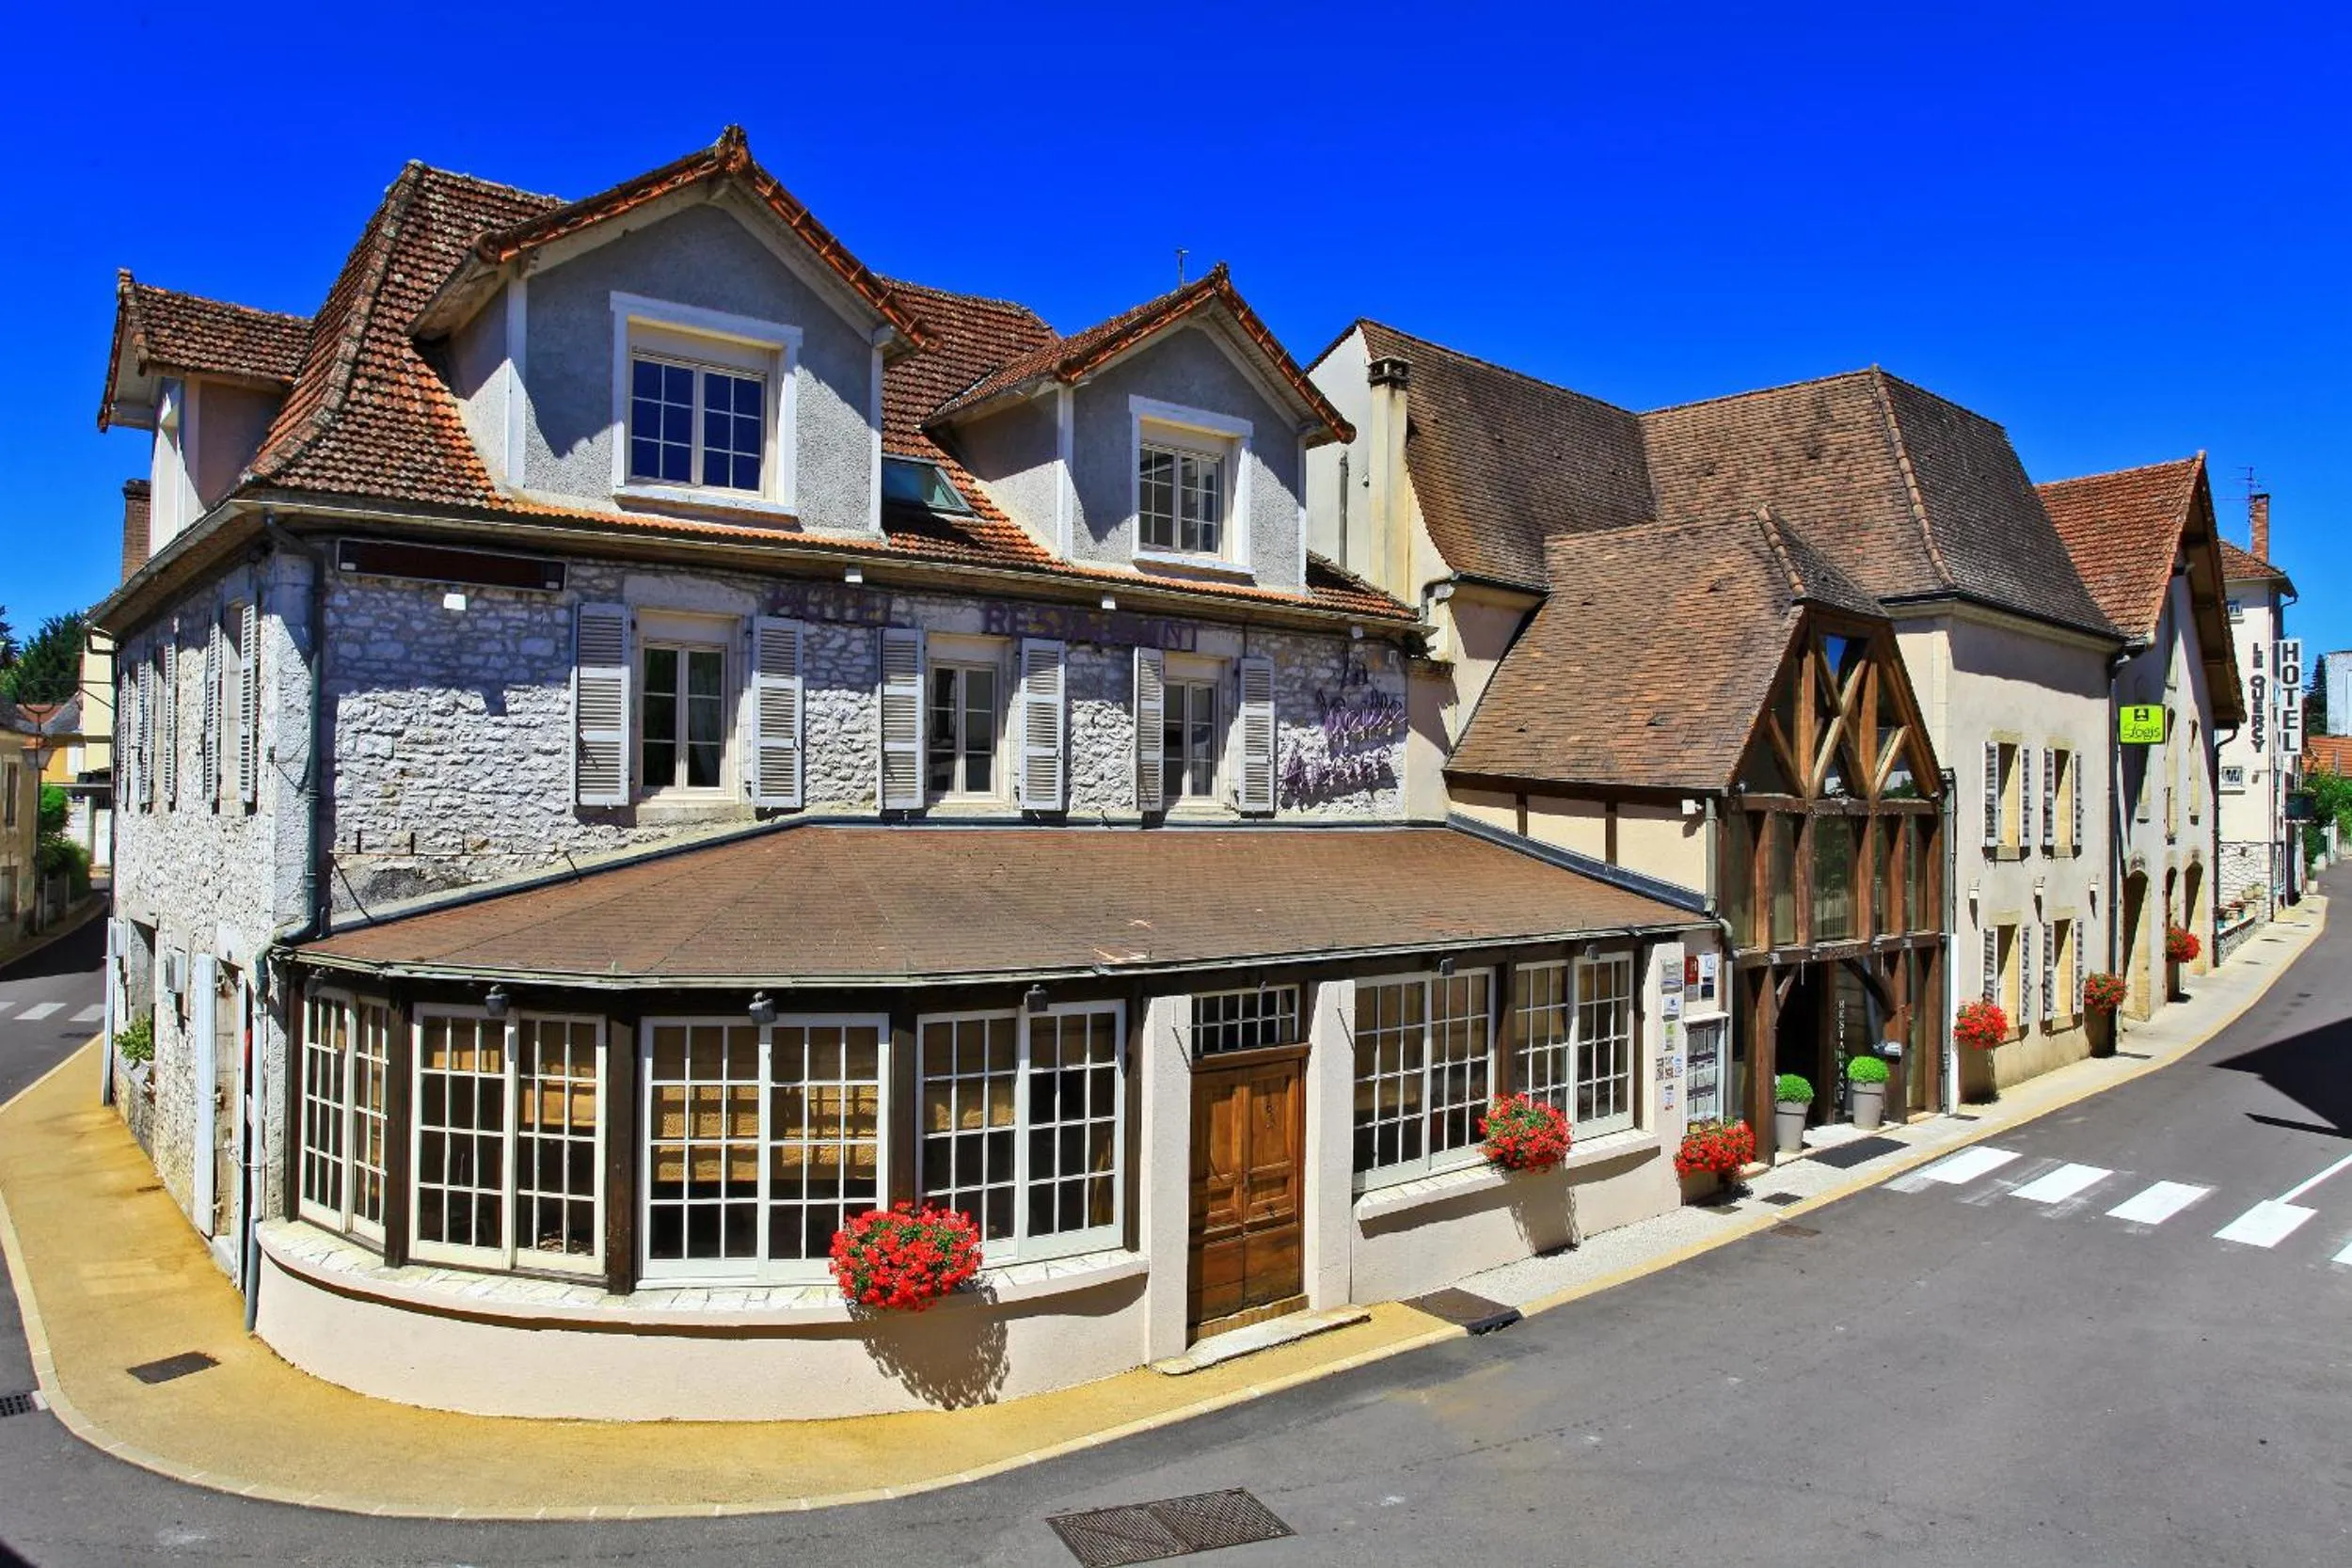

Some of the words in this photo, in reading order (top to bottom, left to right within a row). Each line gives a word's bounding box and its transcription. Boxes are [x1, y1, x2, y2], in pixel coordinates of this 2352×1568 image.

[2252, 641, 2264, 669] LE
[2249, 674, 2265, 753] QUERCY
[2281, 641, 2299, 752] HOTEL
[2123, 722, 2161, 741] Logis
